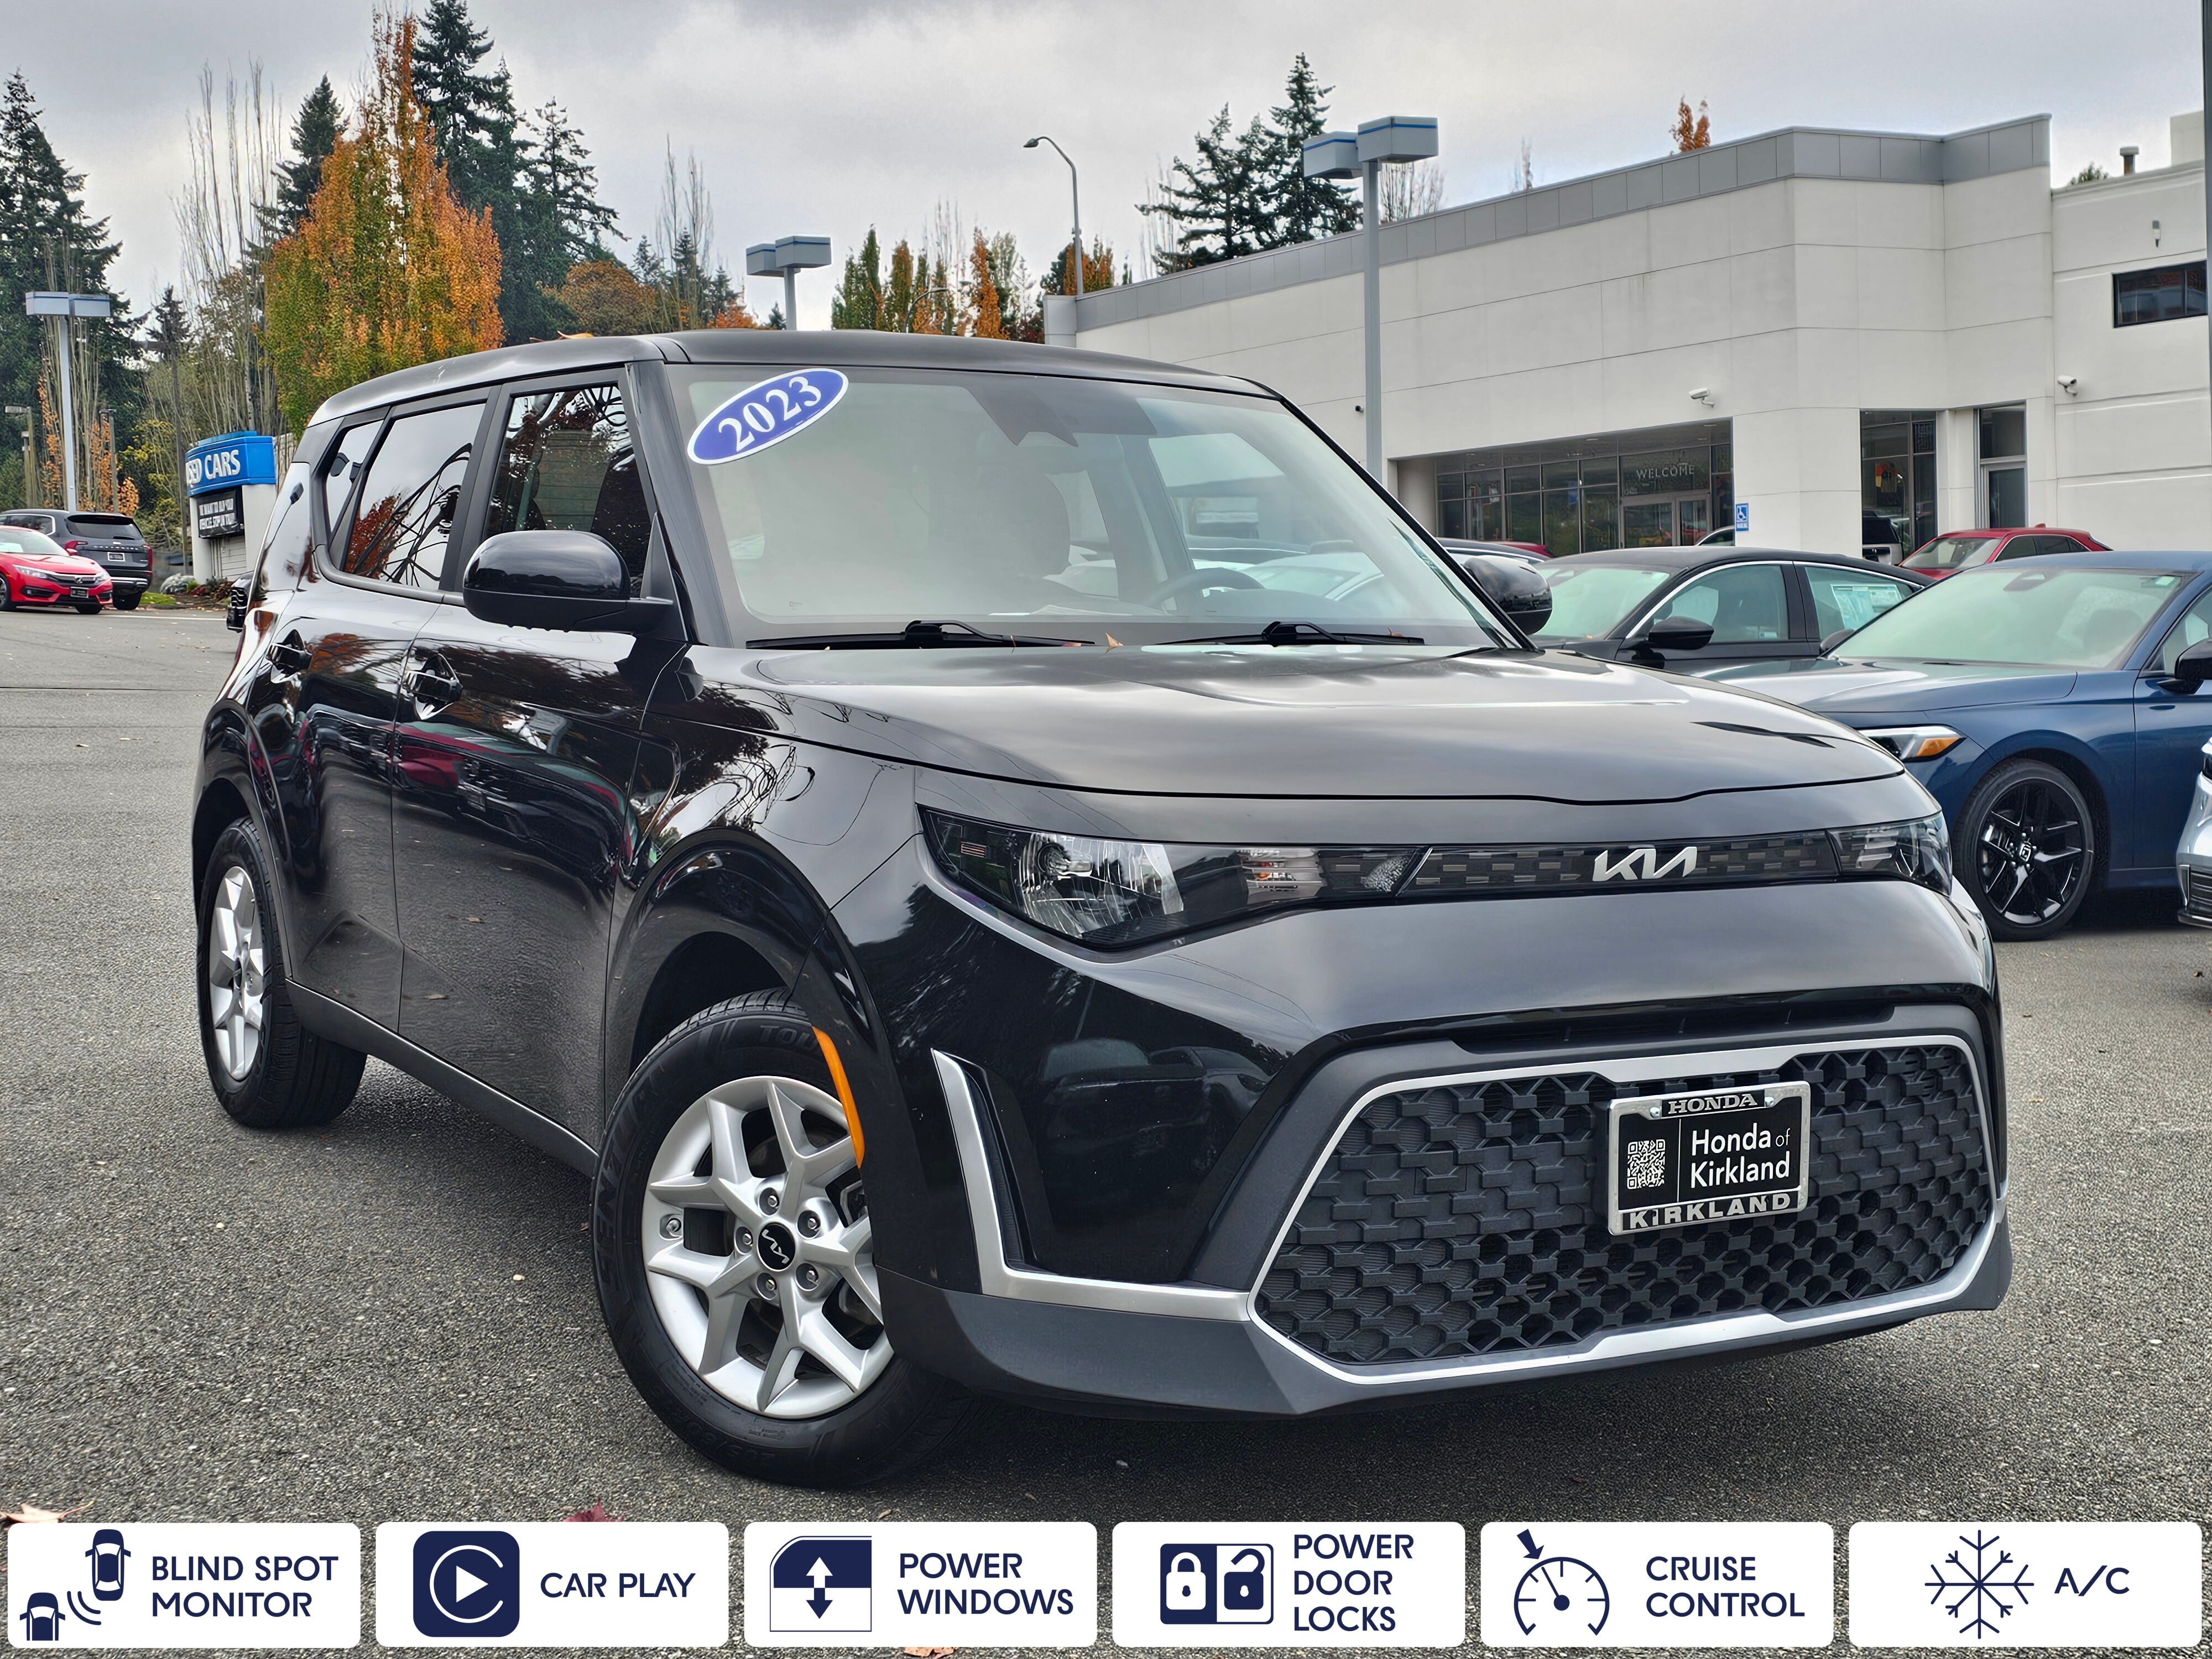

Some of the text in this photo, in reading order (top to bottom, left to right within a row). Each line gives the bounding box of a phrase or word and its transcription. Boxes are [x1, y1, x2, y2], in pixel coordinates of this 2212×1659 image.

[718, 376, 822, 452] 2023
[205, 449, 241, 480] CARS
[1636, 463, 1695, 480] WELCOME
[1592, 846, 1697, 881] KIA
[1667, 1093, 1758, 1115] HONDA
[1692, 1122, 1791, 1156] Honda of
[1691, 1150, 1790, 1188] Kirkland
[1629, 1193, 1791, 1229] KIRKLAND
